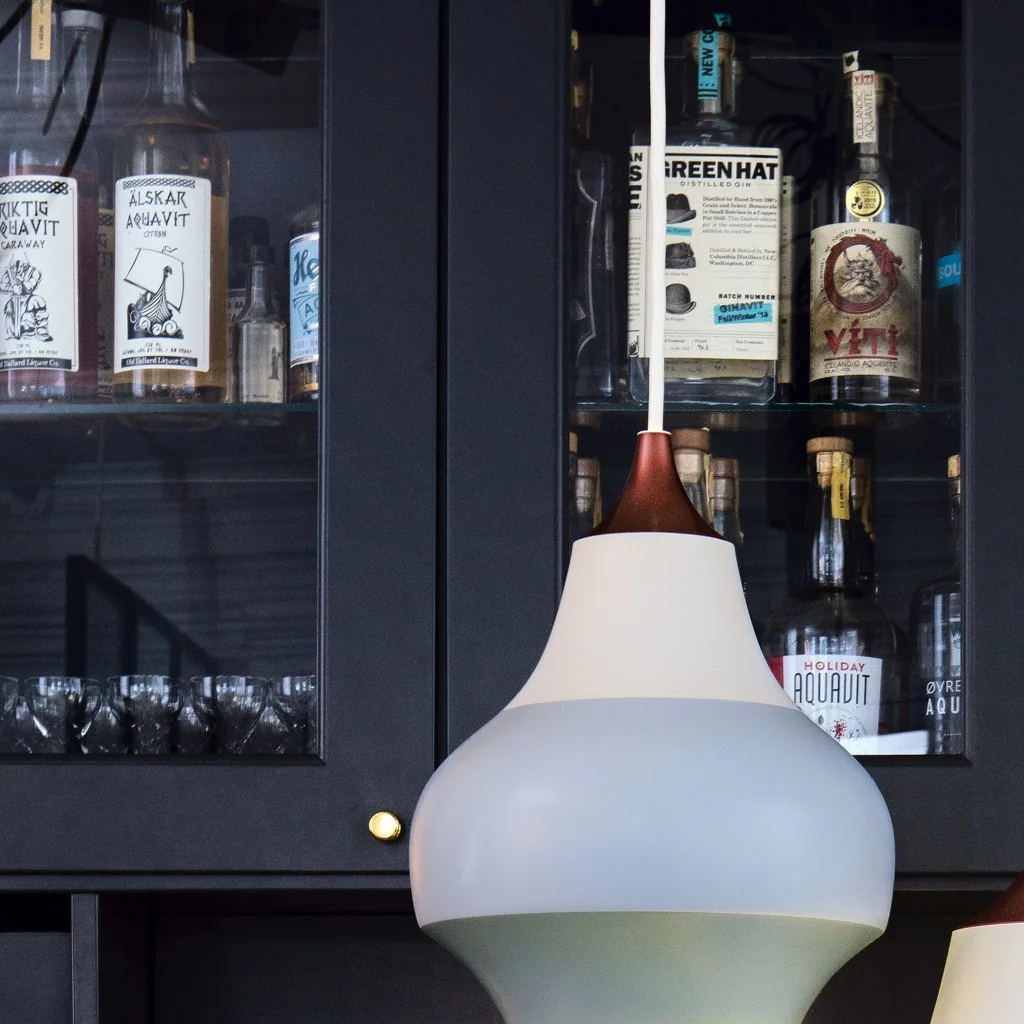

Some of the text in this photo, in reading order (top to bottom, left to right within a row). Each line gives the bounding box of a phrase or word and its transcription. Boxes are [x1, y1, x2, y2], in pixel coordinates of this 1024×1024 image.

[702, 47, 713, 76] NEW
[856, 90, 864, 139] ICELANDIC
[865, 90, 873, 139] AQUAVITE
[736, 162, 778, 180] HAT
[129, 190, 187, 208] ÄLSKAR
[0, 200, 48, 220] RIKTIG
[125, 211, 190, 230] AQUAVIT
[1, 240, 46, 250] CARAWAY
[719, 301, 764, 313] GINAVIT
[804, 661, 865, 672] HOLIDAY
[793, 672, 870, 706] AQUAVIT
[926, 680, 962, 695] ØVRE
[926, 696, 960, 716] AQU
